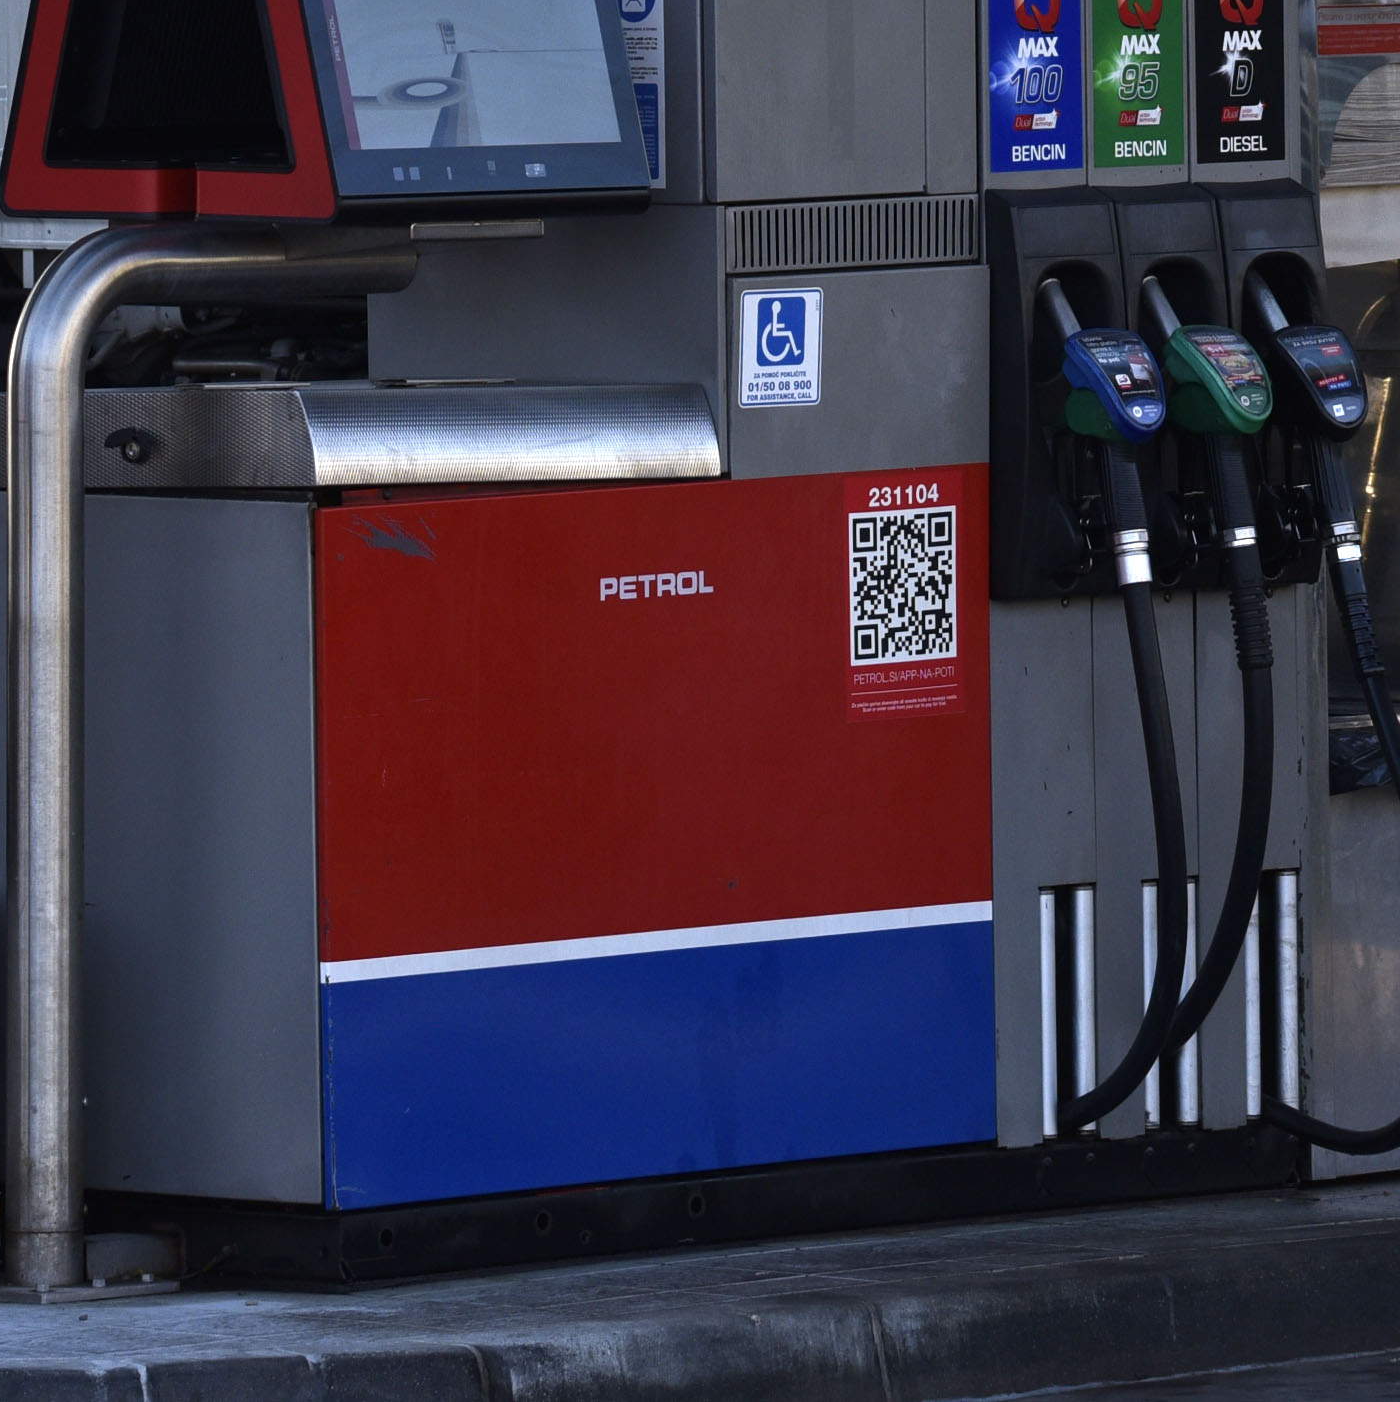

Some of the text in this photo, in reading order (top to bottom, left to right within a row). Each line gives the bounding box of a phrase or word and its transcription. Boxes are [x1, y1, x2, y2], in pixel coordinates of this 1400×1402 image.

[328, 14, 342, 62] PETROL
[1017, 36, 1059, 58] MAX
[1120, 34, 1160, 55] MAX
[1222, 30, 1262, 51] MAX
[1009, 64, 1063, 104] 100
[1118, 62, 1160, 100] 95
[1230, 58, 1254, 97] D
[1012, 144, 1066, 162] BENCIN
[1114, 140, 1167, 158] BENCIN
[1220, 136, 1268, 153] DIESEL
[780, 370, 806, 378] POKLIČITE
[748, 380, 812, 392] 01/50 08 900
[868, 482, 939, 508] 231104
[600, 571, 714, 601] PETROL
[853, 666, 955, 685] PETROL.SI/APP-NA-POTI
